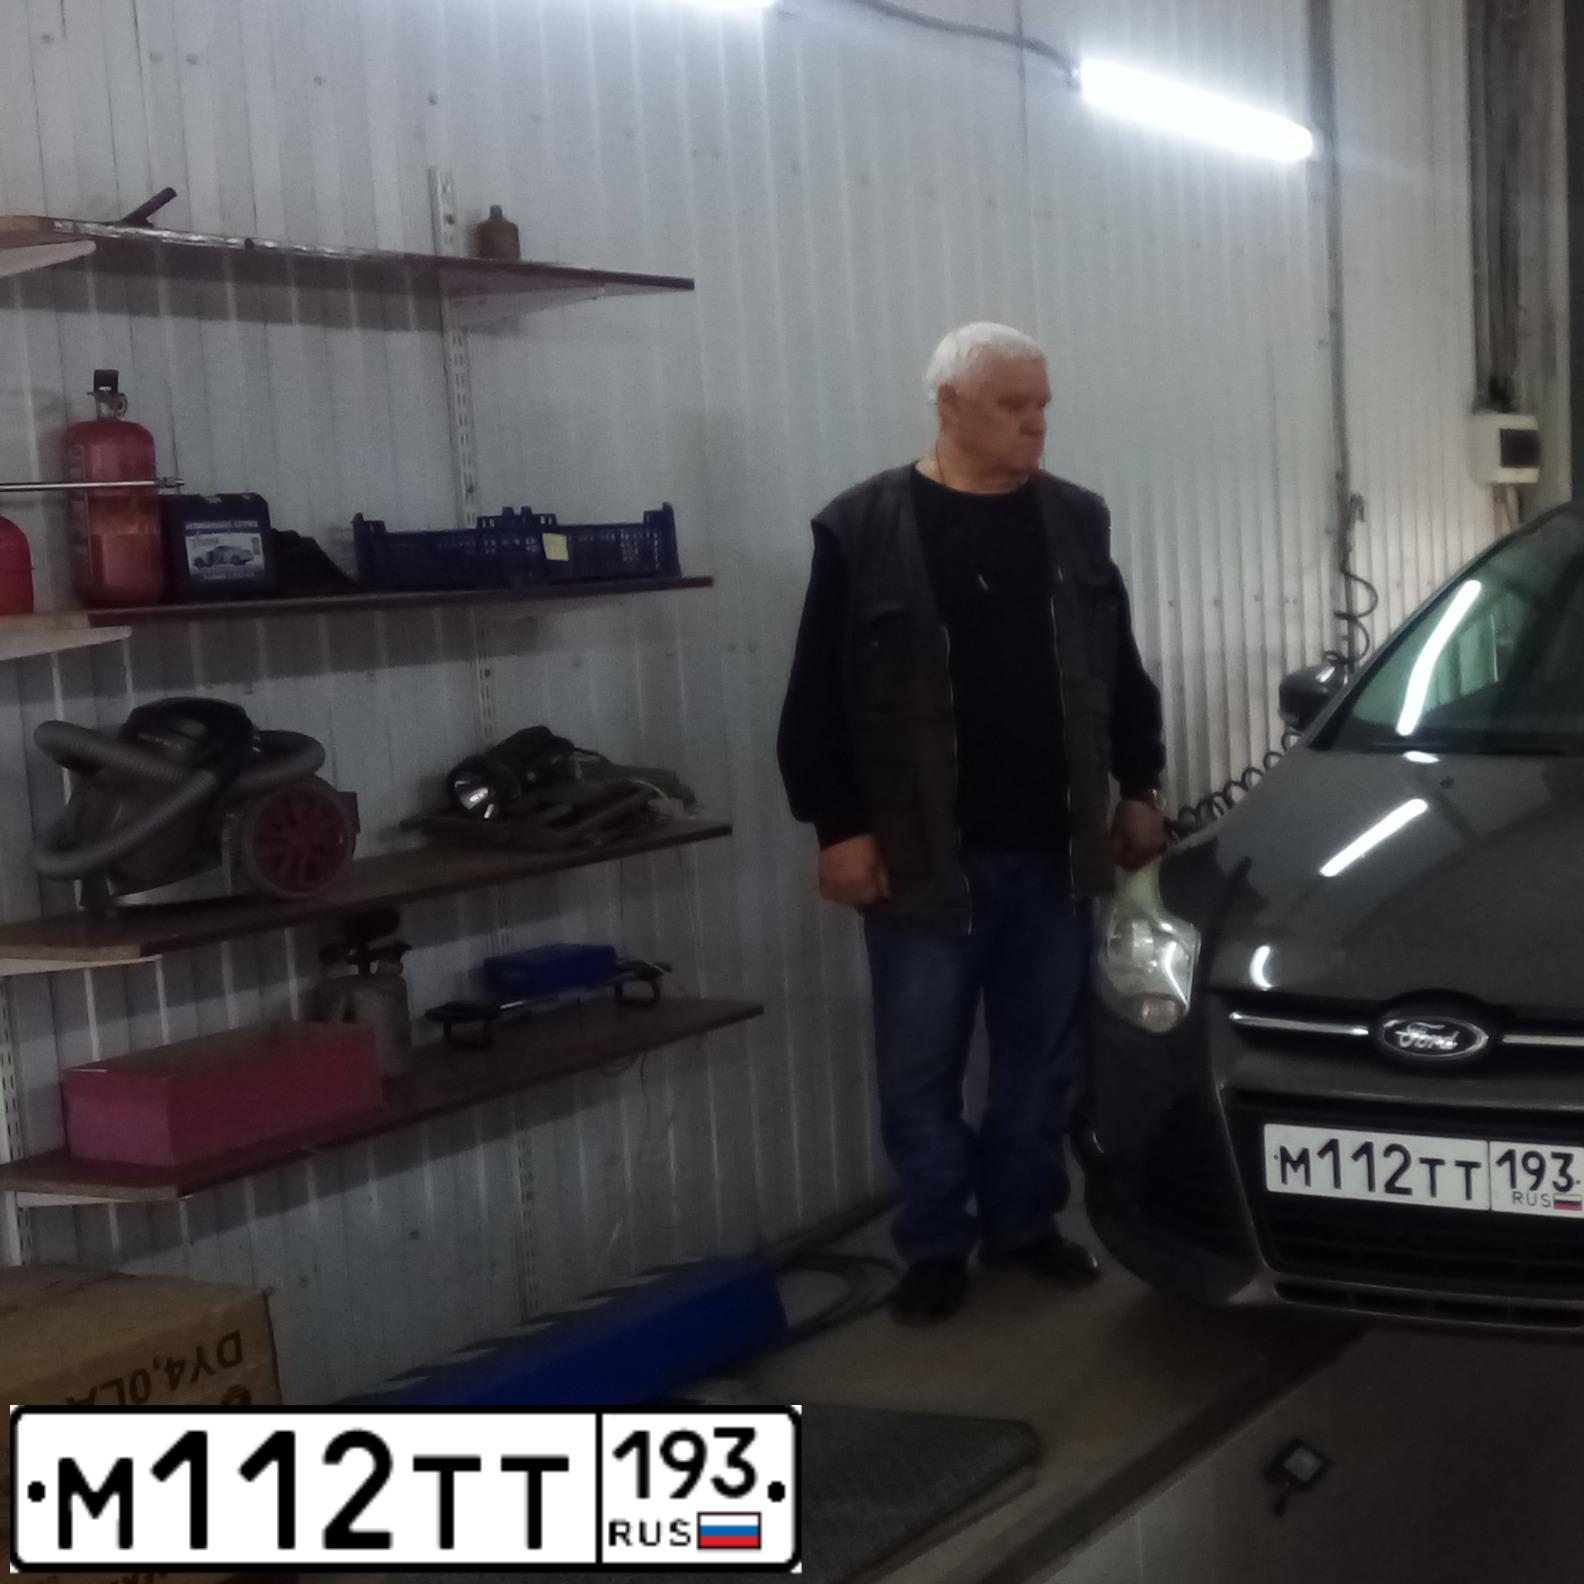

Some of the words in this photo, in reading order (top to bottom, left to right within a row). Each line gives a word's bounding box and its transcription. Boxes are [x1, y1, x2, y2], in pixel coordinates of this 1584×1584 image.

[1395, 1021, 1459, 1050] Ford
[1279, 1138, 1482, 1201] М112ТТ
[1496, 1149, 1574, 1193] 193
[1511, 1190, 1551, 1209] RUS
